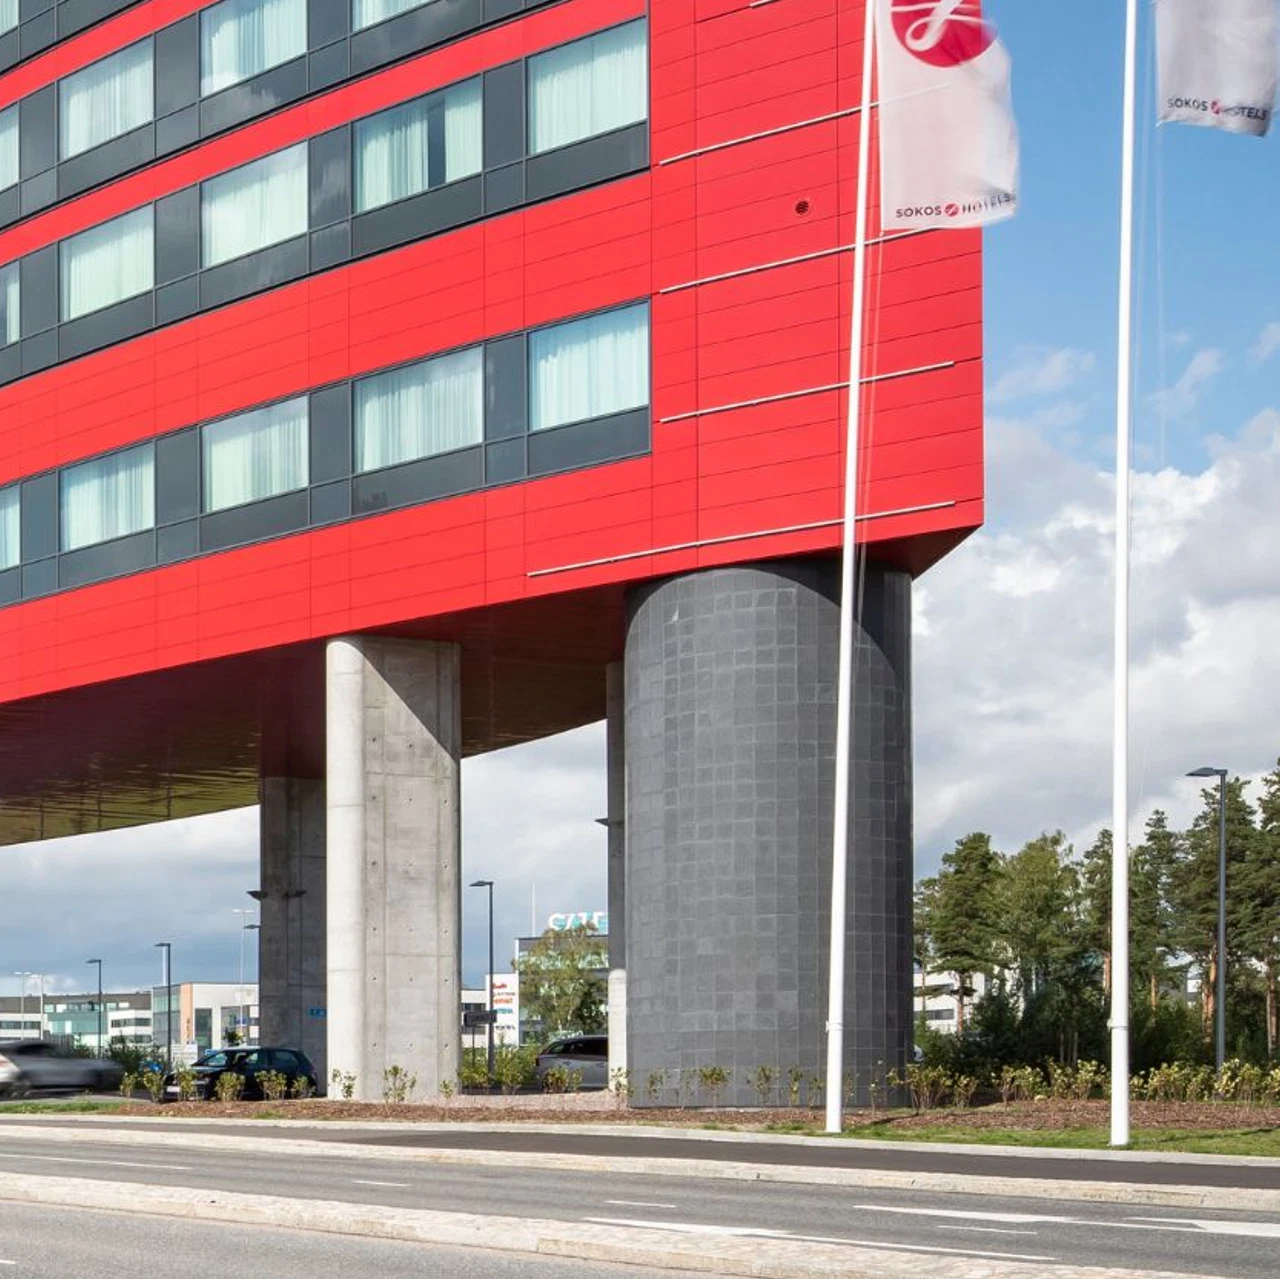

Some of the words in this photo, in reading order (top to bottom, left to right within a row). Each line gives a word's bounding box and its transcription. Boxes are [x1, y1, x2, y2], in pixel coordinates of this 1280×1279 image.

[1166, 97, 1209, 111] SOKOS
[1221, 105, 1269, 121] TELS
[895, 205, 942, 219] SOKOS
[962, 192, 1011, 214] HOTELS
